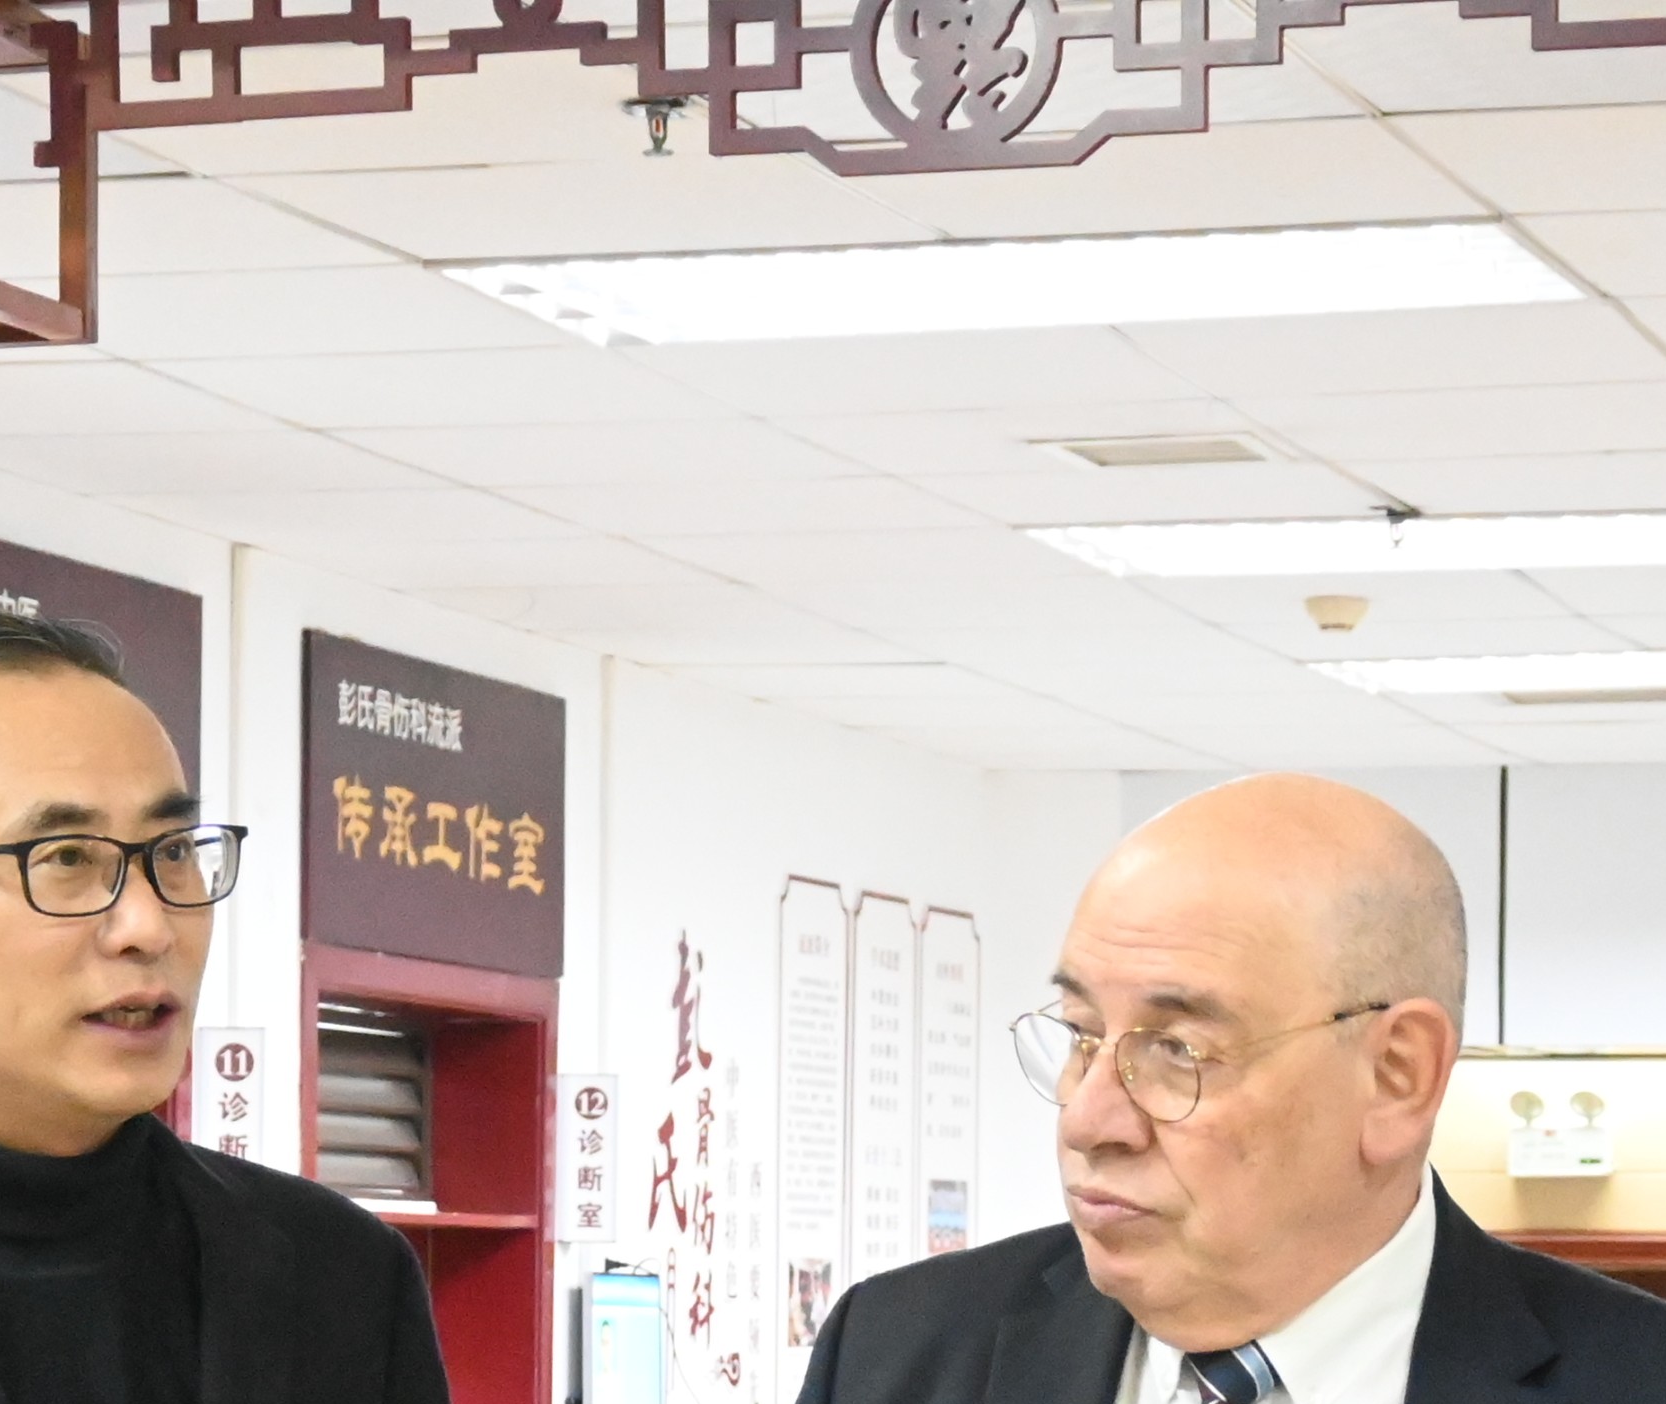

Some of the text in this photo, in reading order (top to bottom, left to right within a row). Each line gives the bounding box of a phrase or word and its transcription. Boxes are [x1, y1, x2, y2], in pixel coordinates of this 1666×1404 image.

[337, 678, 464, 753] 彭氏骨伤科流派
[332, 773, 546, 896] 传承工作室
[217, 1046, 252, 1079] 11
[576, 1089, 607, 1118] 12
[577, 1129, 605, 1229] 诊断室
